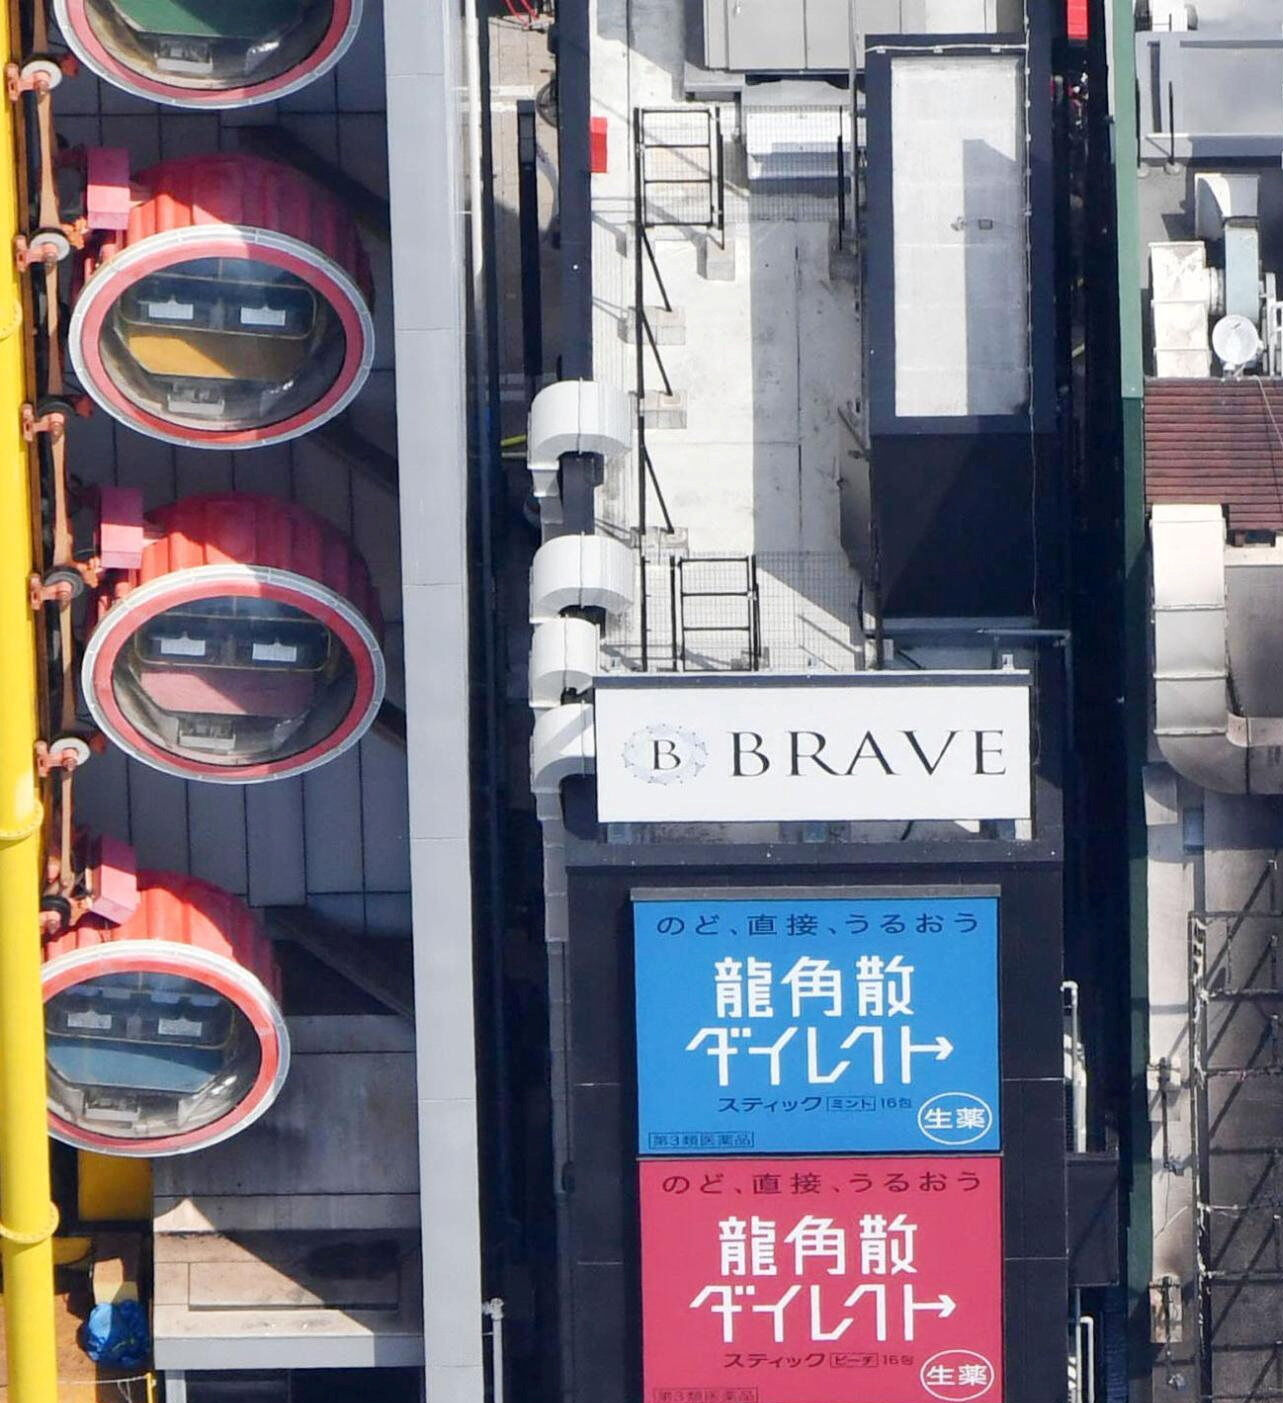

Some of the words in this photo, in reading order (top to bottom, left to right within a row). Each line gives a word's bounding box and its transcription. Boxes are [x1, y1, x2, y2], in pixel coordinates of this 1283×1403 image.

[653, 740, 681, 770] B
[730, 729, 1007, 777] BRAVE
[657, 912, 979, 936] のど、直接、うるおう
[714, 955, 915, 1018] 龍角散
[686, 1025, 955, 1086] ダイレクト
[717, 1096, 822, 1112] スティック
[924, 1106, 990, 1130] 生薬
[662, 1171, 982, 1195] のど、直接、うるおう
[718, 1213, 918, 1277] 龍角散
[690, 1283, 958, 1344] ダイレクト
[724, 1353, 825, 1369] スティック
[927, 1364, 989, 1386] 生薬
